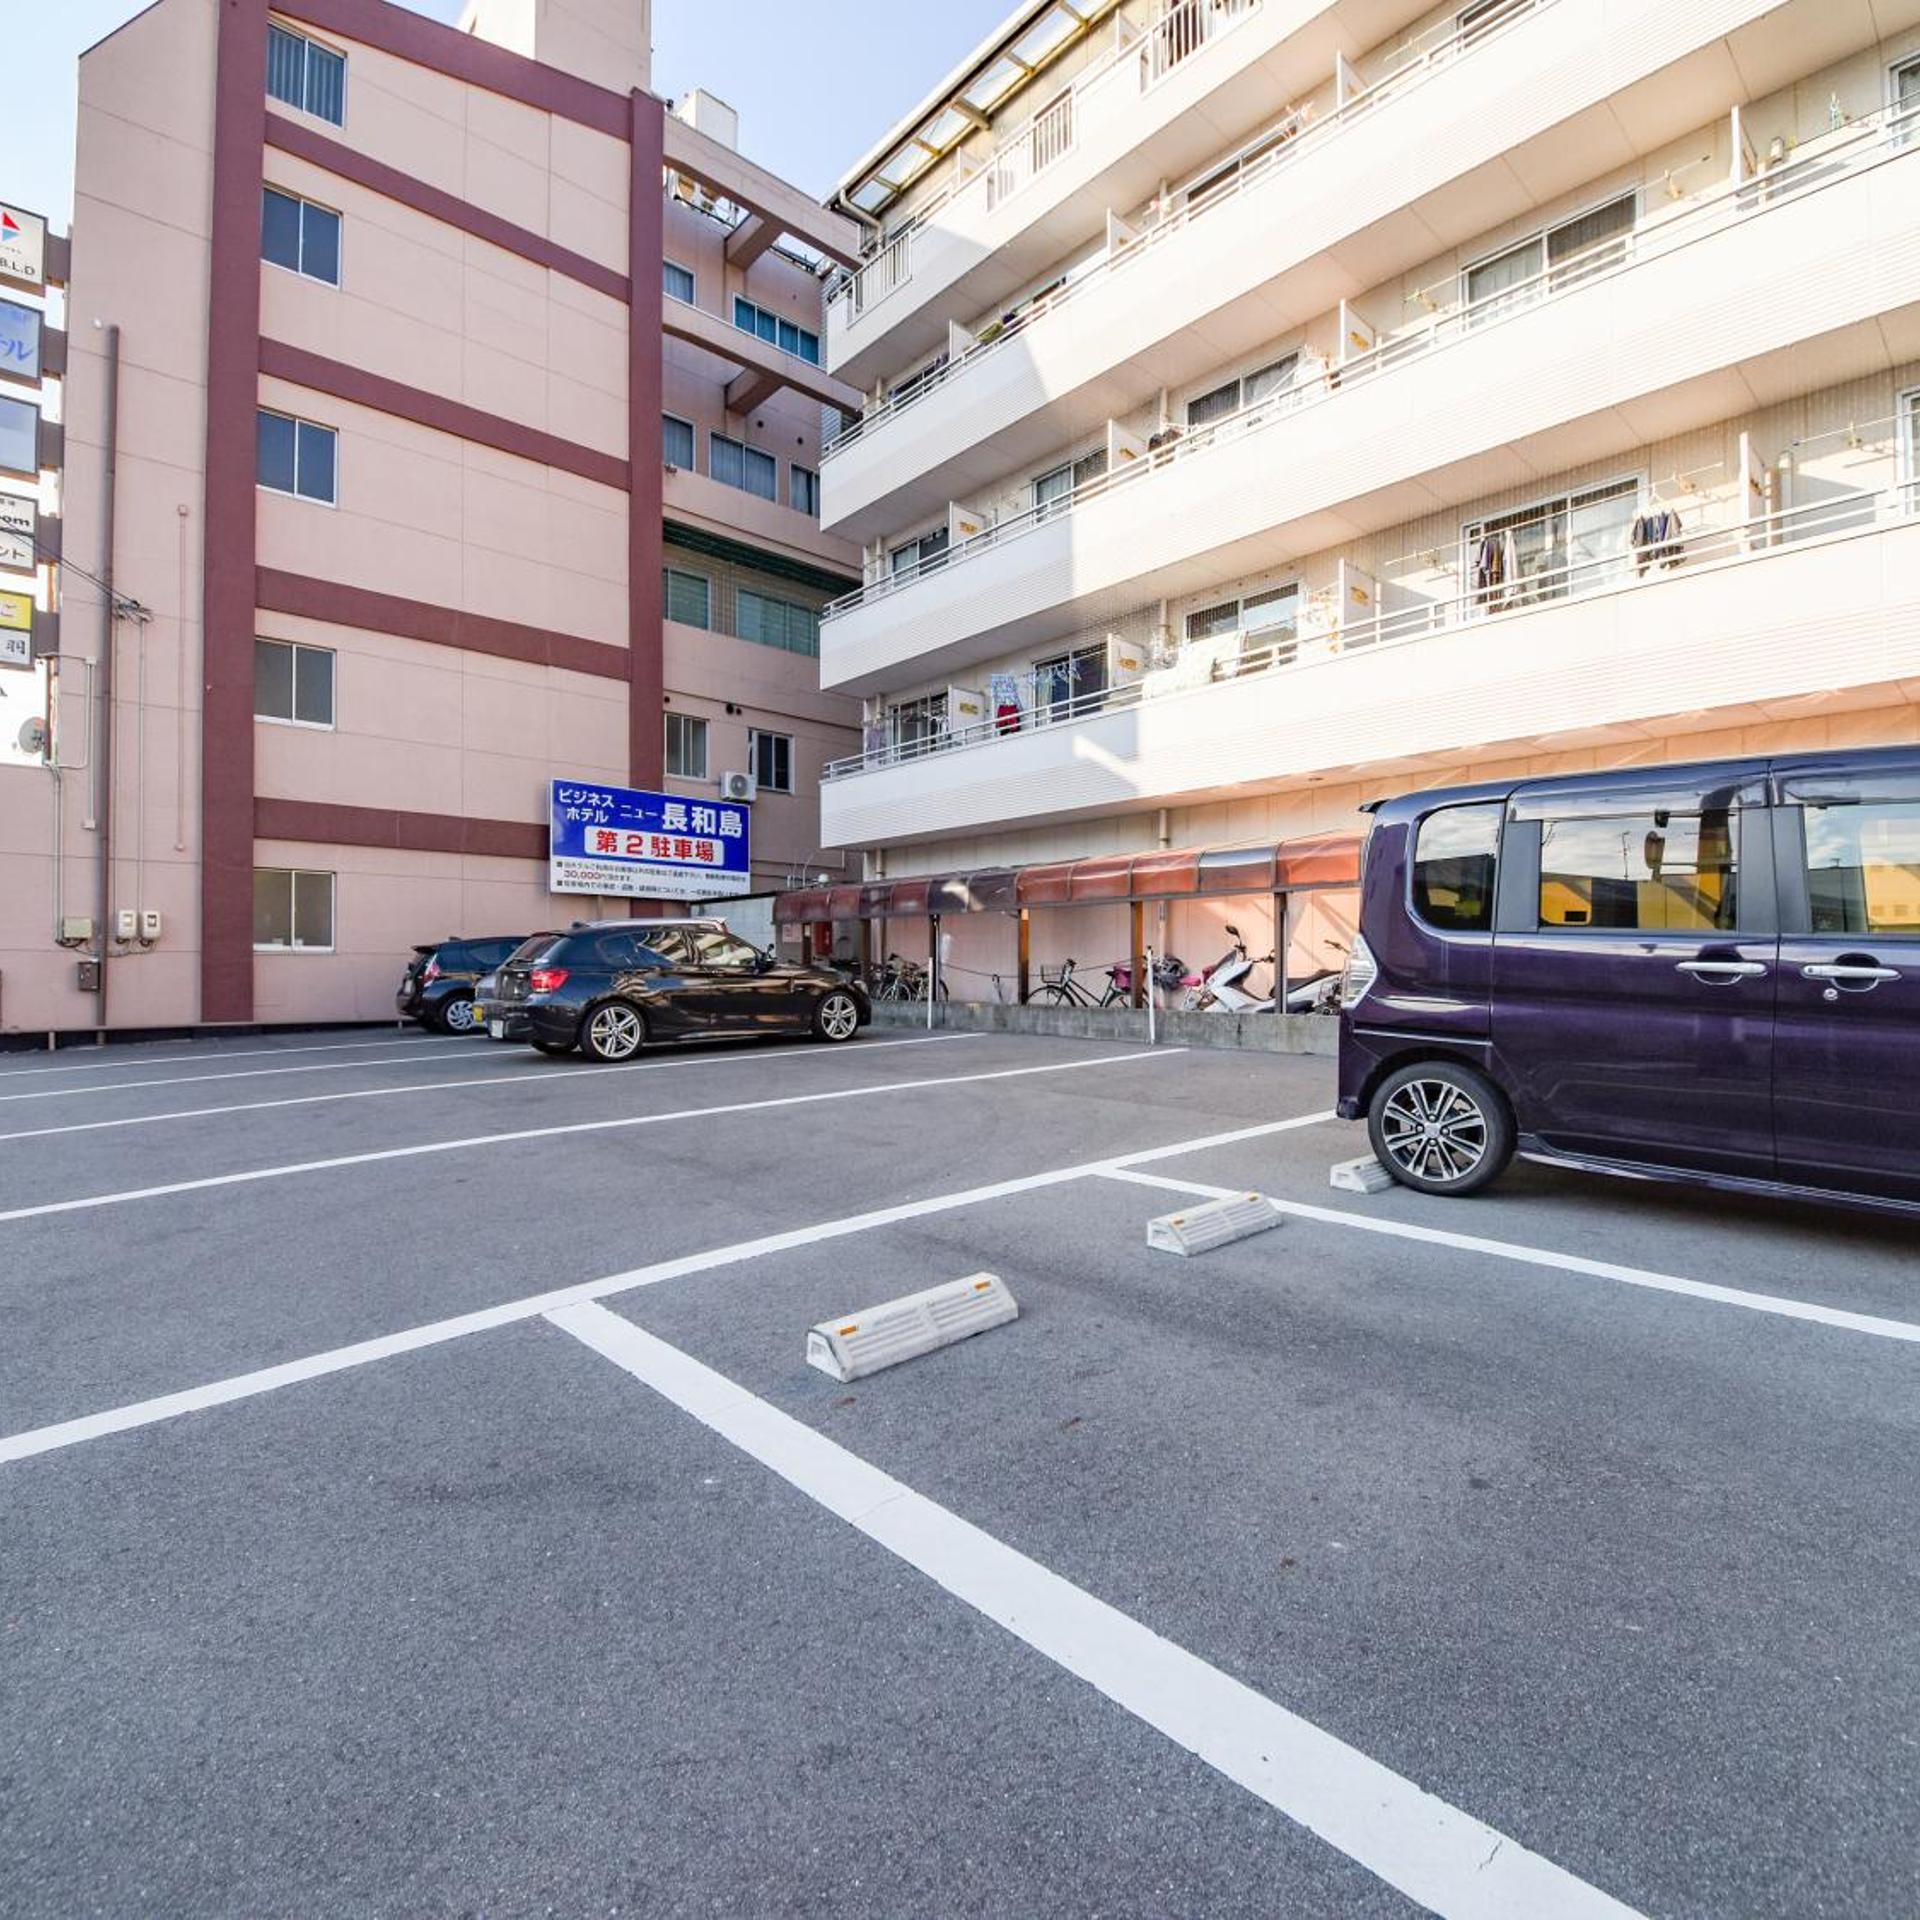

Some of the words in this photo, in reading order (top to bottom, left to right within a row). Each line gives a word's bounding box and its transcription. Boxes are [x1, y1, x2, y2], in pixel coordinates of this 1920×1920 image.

[559, 788, 615, 808] ビジネス
[566, 806, 609, 824] ホテル
[620, 804, 657, 818] ニュー
[662, 802, 743, 838] 長和島
[596, 829, 714, 862] 第2駐車場
